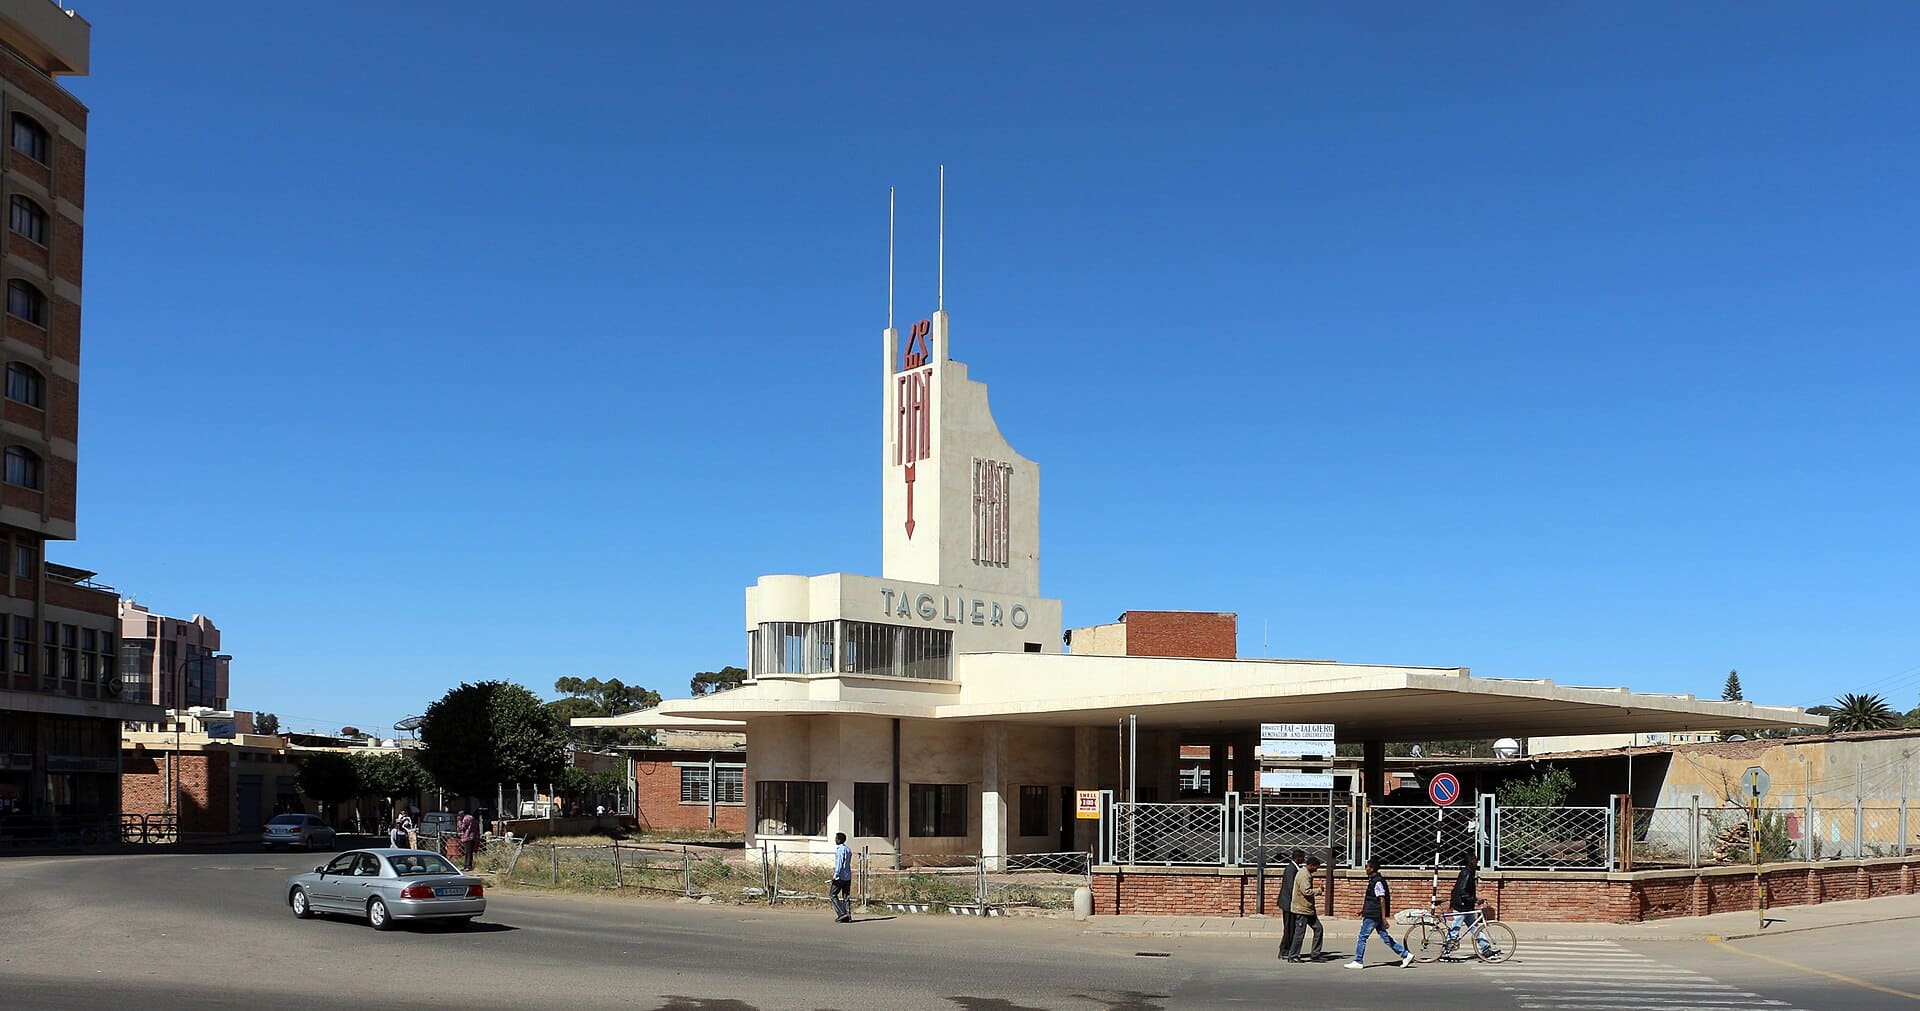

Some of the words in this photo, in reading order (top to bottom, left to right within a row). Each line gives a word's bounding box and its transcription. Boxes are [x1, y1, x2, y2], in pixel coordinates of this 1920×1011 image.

[897, 368, 932, 466] FIAT
[971, 456, 1013, 566] FIAT
[880, 587, 1029, 629] TAGLIERO
